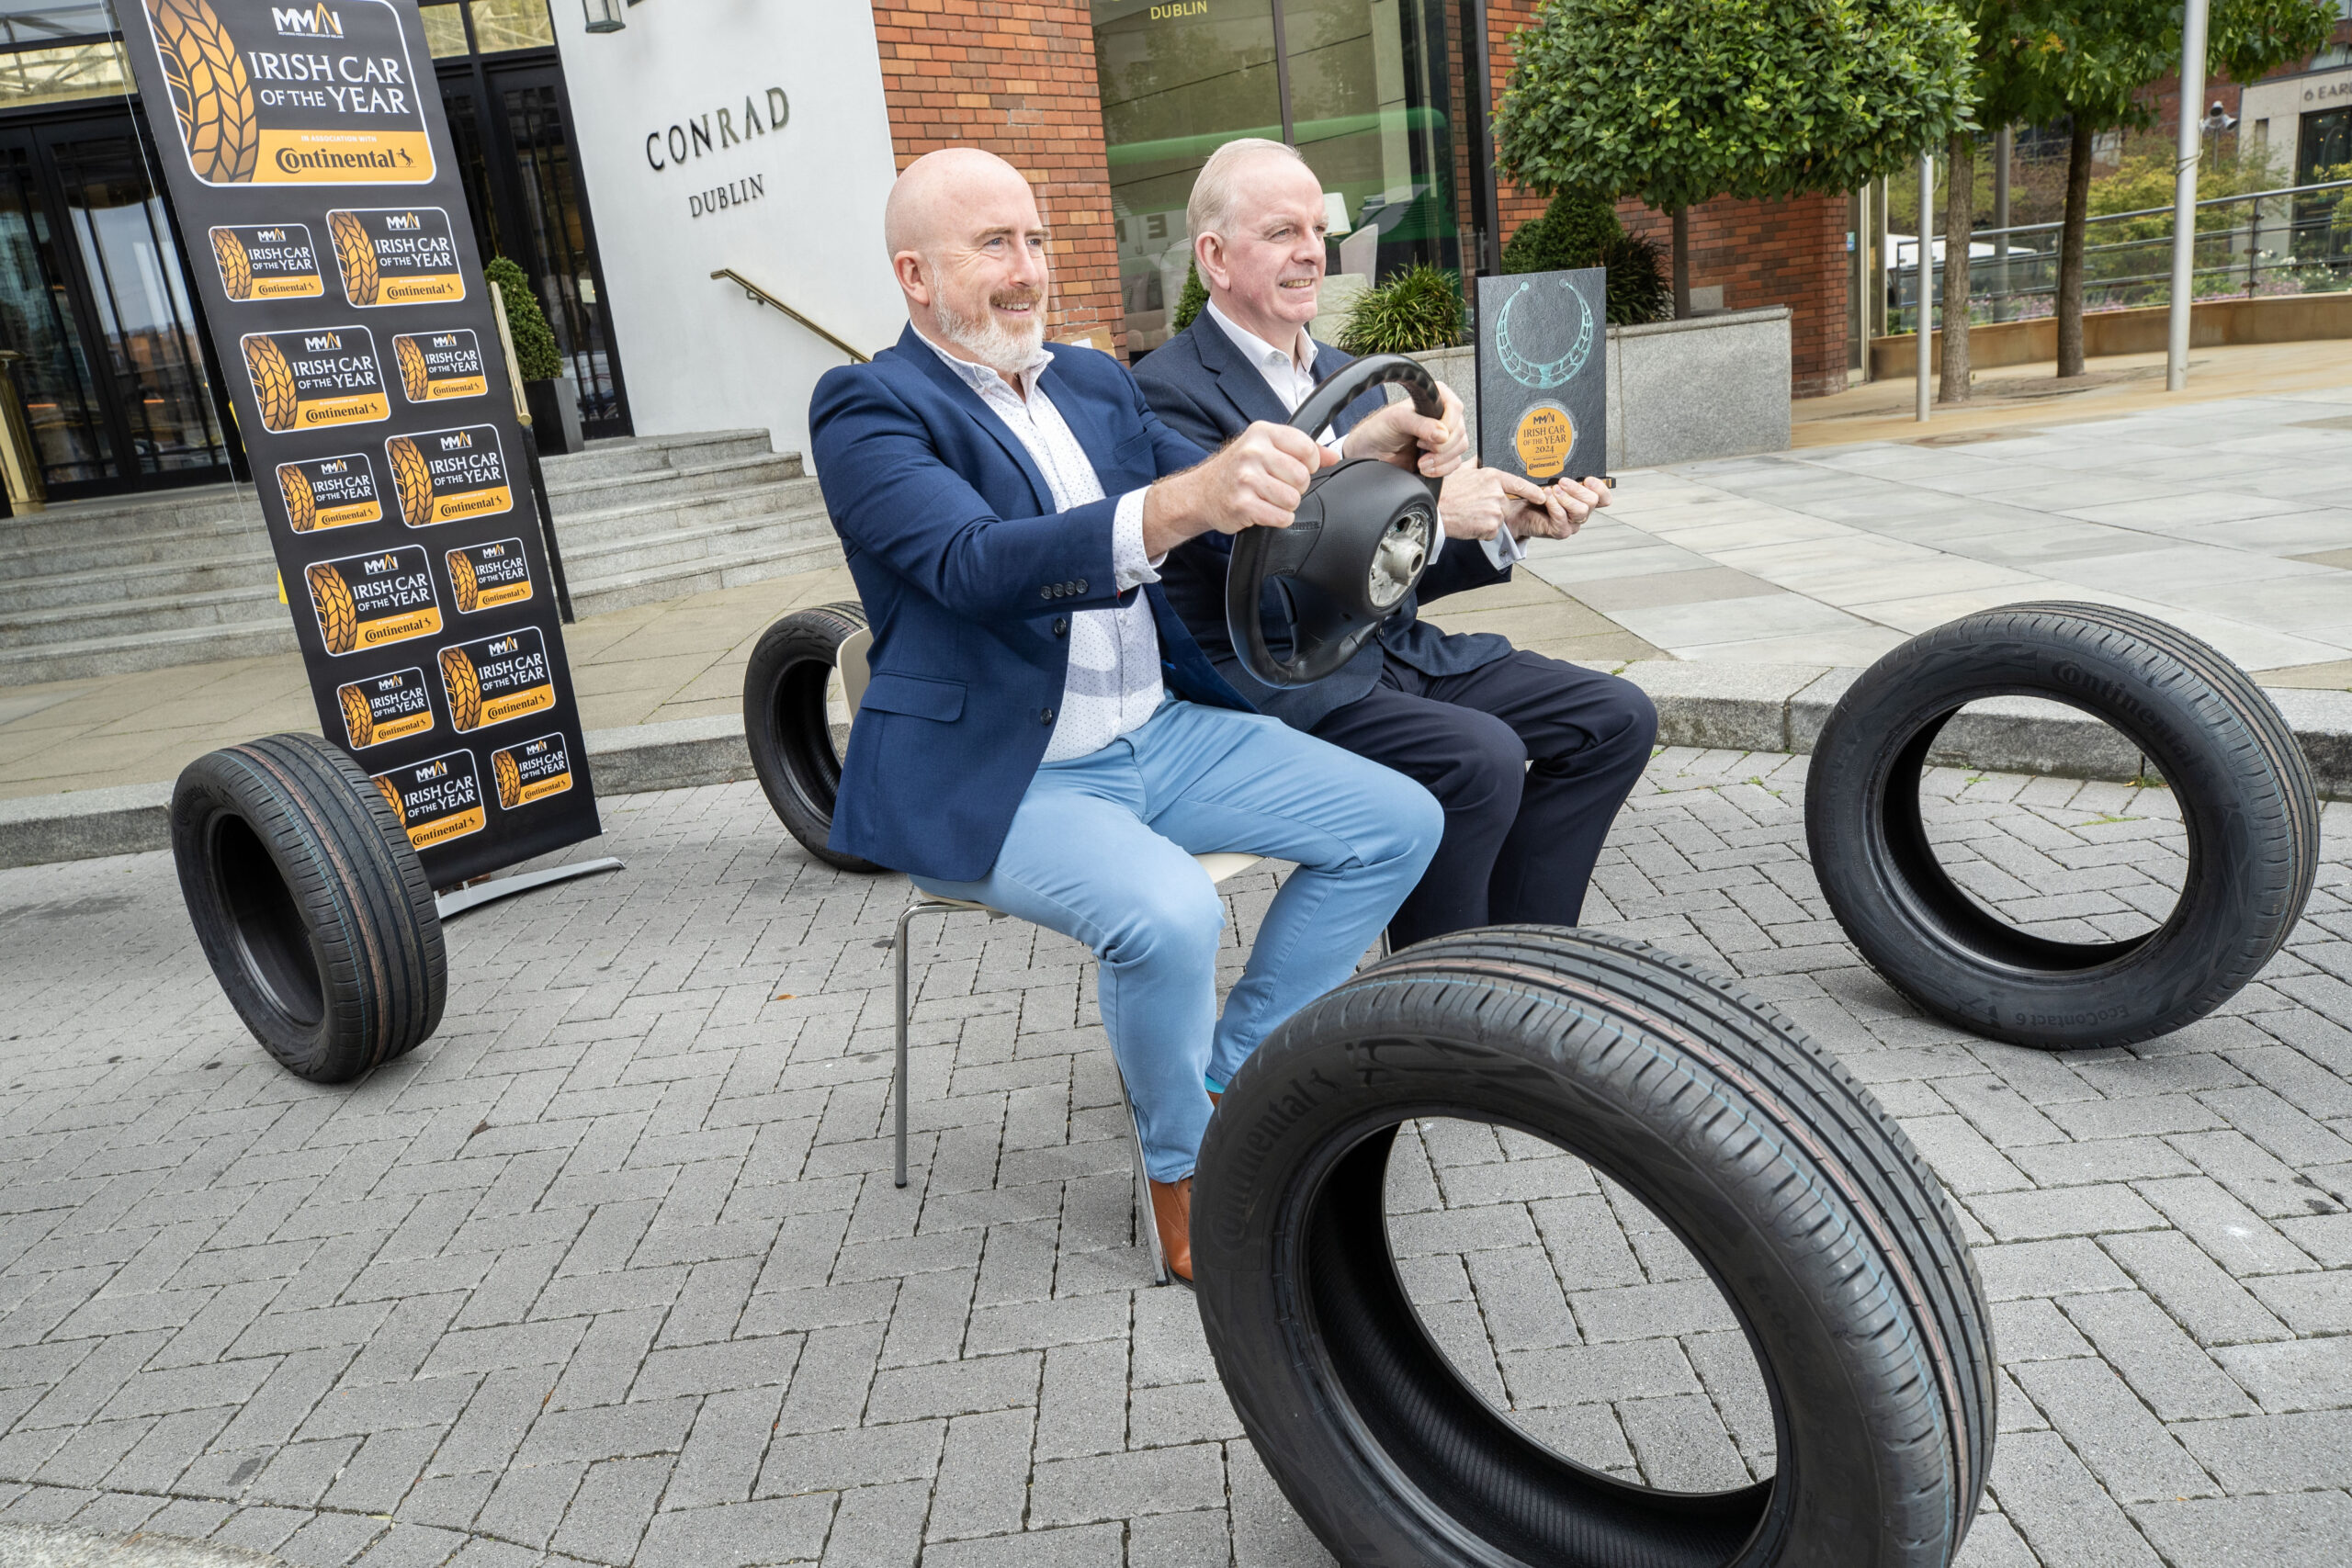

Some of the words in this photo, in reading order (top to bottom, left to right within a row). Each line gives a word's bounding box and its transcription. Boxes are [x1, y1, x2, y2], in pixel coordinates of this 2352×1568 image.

[1150, 0, 1208, 20] DUBLIN
[248, 51, 334, 82] IRISH
[338, 56, 404, 84] CAR
[260, 89, 285, 106] OF
[287, 90, 326, 107] THE
[325, 86, 410, 114] YEAR
[2303, 88, 2314, 102] 6
[646, 86, 789, 172] CONRAD
[276, 148, 396, 174] Continental
[688, 174, 765, 218] DUBLIN
[247, 248, 282, 260] IRISH
[283, 247, 311, 258] CAR
[374, 238, 416, 253] IRISH
[417, 237, 450, 252] CAR
[277, 258, 313, 270] YEAR
[379, 257, 391, 266] OF
[392, 256, 412, 265] THE
[411, 252, 453, 267] YEAR
[258, 283, 307, 295] Continental
[386, 284, 445, 299] Continental
[291, 358, 337, 376] IRISH
[338, 355, 374, 371] CAR
[424, 352, 453, 364] IRISH
[454, 350, 477, 361] CAR
[449, 360, 479, 372] YEAR
[298, 379, 311, 389] OF
[311, 378, 333, 388] THE
[331, 371, 377, 388] YEAR
[433, 383, 473, 396] Continental
[305, 403, 368, 423] Continental
[1523, 426, 1546, 438] IRISH
[1547, 423, 1566, 435] CAR
[1532, 437, 1544, 446] THE
[1544, 434, 1566, 445] YEAR
[1535, 445, 1555, 455] 2024
[429, 456, 468, 474] IRISH
[469, 452, 499, 468] CAR
[1528, 461, 1556, 470] Continental
[311, 478, 344, 492] IRISH
[345, 475, 370, 487] CAR
[434, 477, 446, 486] OF
[446, 474, 464, 484] THE
[462, 467, 502, 483] YEAR
[325, 491, 341, 500] THE
[340, 486, 372, 499] YEAR
[440, 497, 494, 516] Continental
[322, 509, 367, 525] Continental
[475, 561, 502, 575] IRISH
[502, 557, 524, 570] CAR
[497, 567, 525, 581] YEAR
[352, 579, 393, 599] IRISH
[395, 573, 428, 591] CAR
[357, 602, 369, 611] OF
[370, 597, 390, 608] THE
[389, 588, 430, 606] YEAR
[481, 589, 519, 604] Continental
[364, 619, 423, 642] Continental
[478, 660, 514, 680] IRISH
[514, 653, 543, 670] CAR
[482, 681, 492, 691] OF
[492, 677, 510, 687] THE
[509, 666, 545, 685] YEAR
[369, 693, 399, 708] IRISH
[400, 687, 424, 701] CAR
[382, 705, 396, 715] THE
[395, 697, 425, 712] YEAR
[487, 695, 537, 719] Continental
[2052, 660, 2199, 769] Continental
[378, 720, 420, 739] Continental
[518, 756, 544, 772] IRISH
[544, 750, 564, 763] CAR
[539, 760, 565, 774] YEAR
[403, 784, 442, 807] IRISH
[444, 775, 474, 794] CAR
[525, 781, 560, 799] Continental
[408, 807, 419, 817] OF
[419, 802, 437, 813] THE
[436, 789, 475, 809] YEAR
[413, 818, 467, 846] Continental
[2030, 1004, 2131, 1029] EcoContact
[1210, 1077, 1324, 1252] Continental
